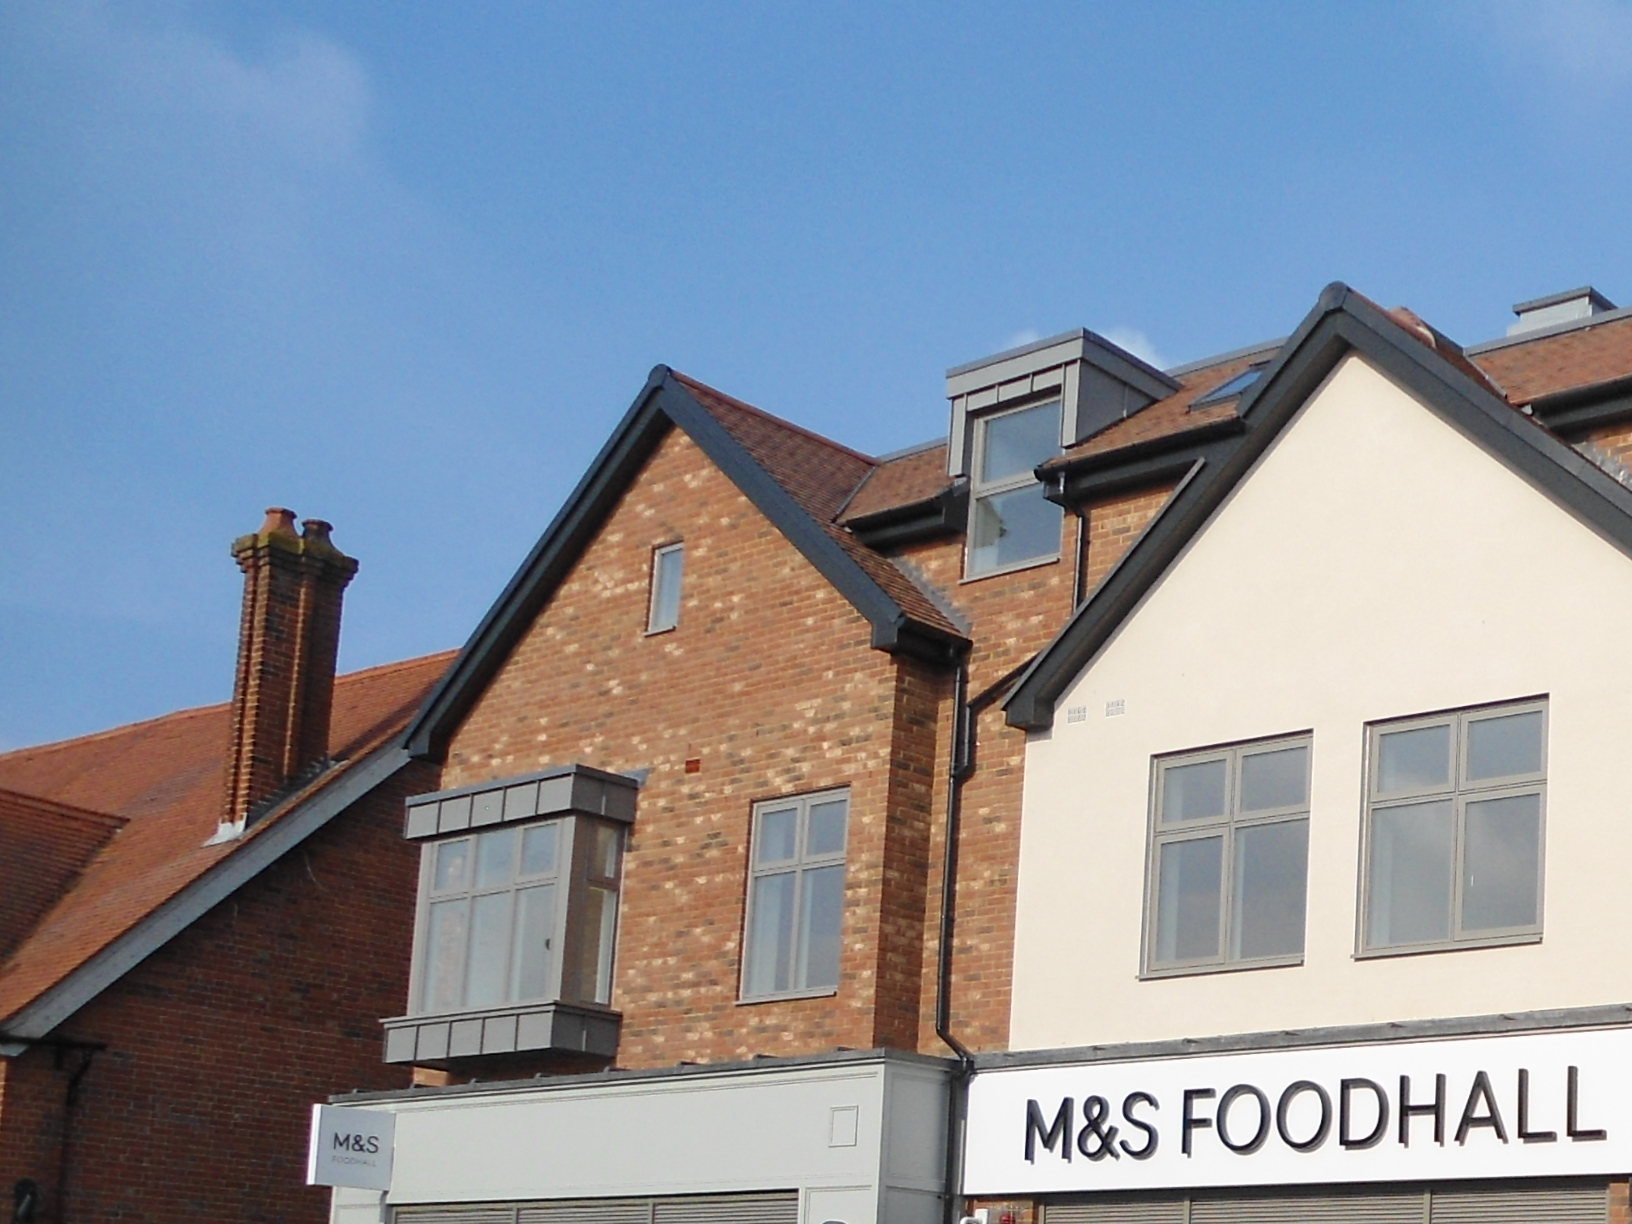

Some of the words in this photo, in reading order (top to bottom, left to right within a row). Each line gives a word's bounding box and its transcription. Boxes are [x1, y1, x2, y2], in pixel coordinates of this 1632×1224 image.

[333, 1131, 379, 1154] M&S
[1024, 1091, 1160, 1165] M&S
[1181, 1065, 1608, 1159] FOODHALL
